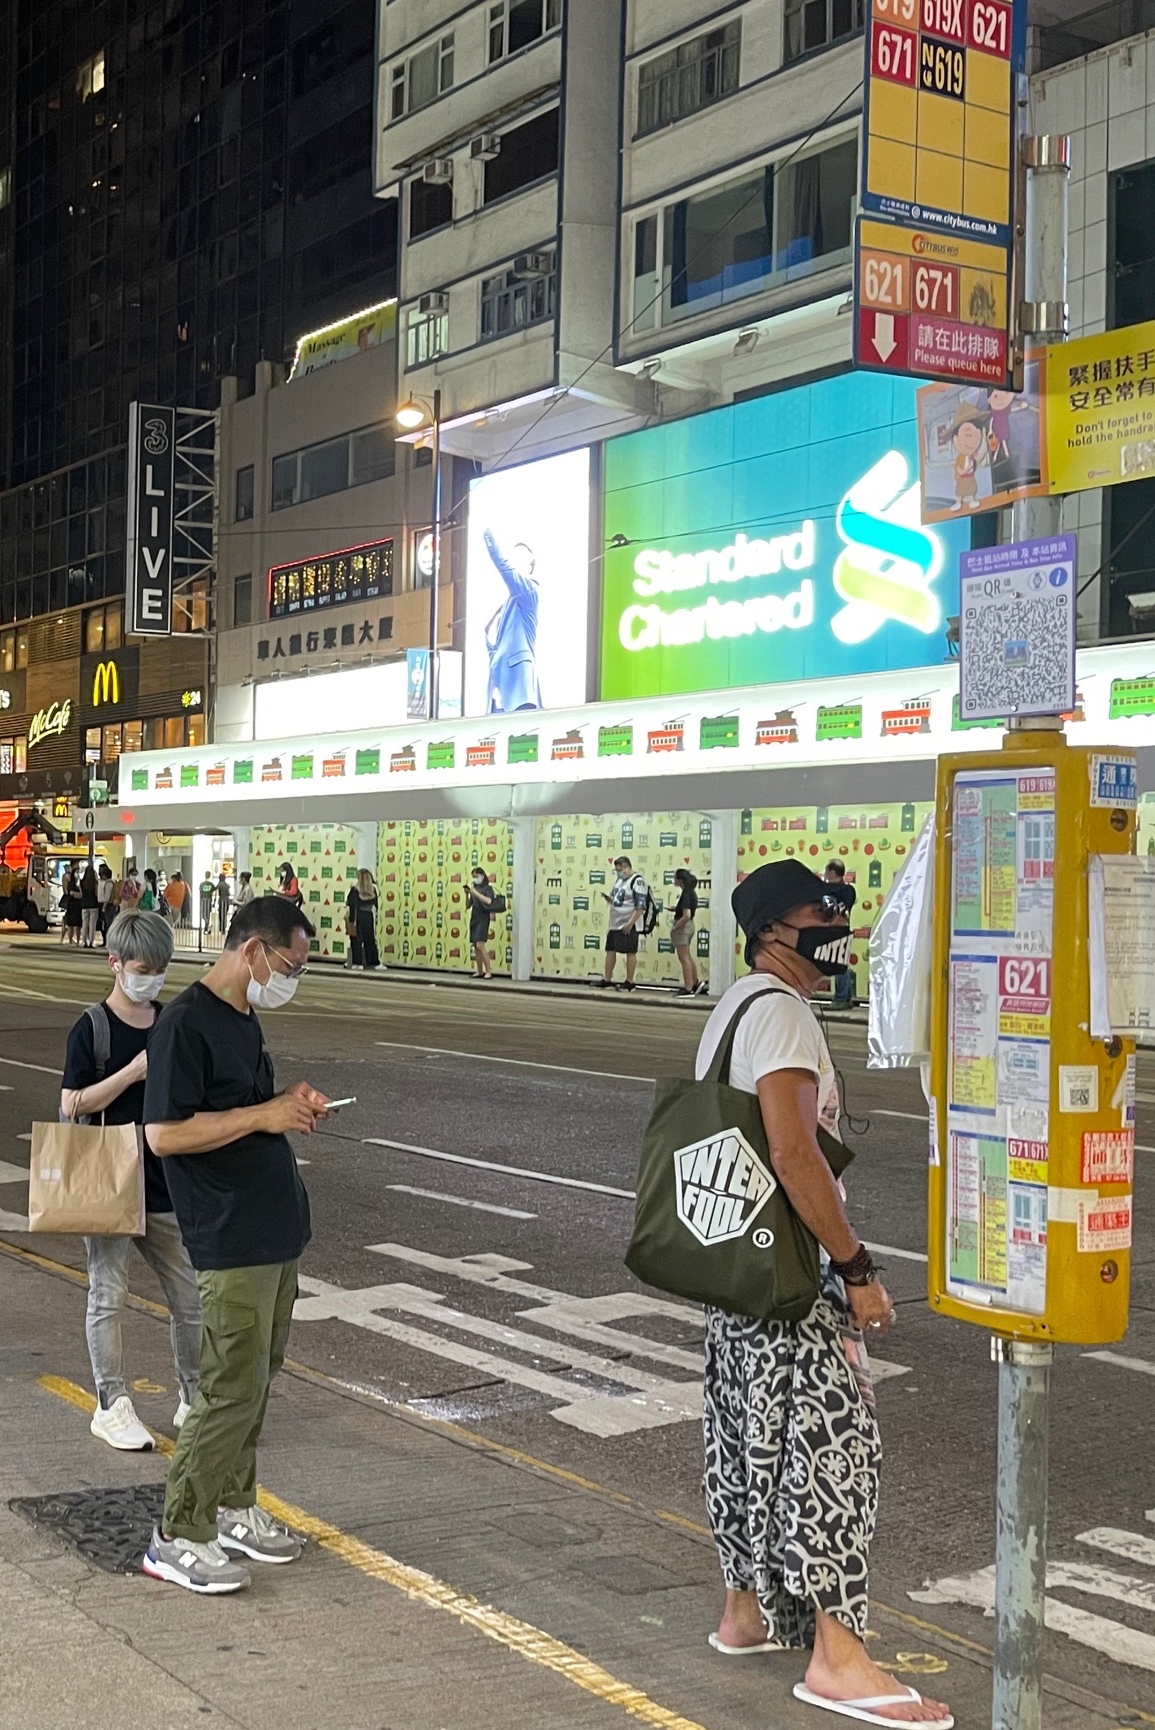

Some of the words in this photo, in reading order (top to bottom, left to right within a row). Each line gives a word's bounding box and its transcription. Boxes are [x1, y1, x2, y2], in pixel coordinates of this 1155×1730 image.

[973, 3, 1007, 52] 621
[878, 30, 912, 79] 671
[922, 209, 998, 235] www.citybus.com.hk
[865, 258, 903, 306] 621
[915, 266, 953, 314] 671
[918, 323, 999, 359] 請在此排隊
[914, 349, 946, 366] Please
[948, 357, 978, 374] queue
[980, 361, 1002, 377] here
[1068, 349, 1155, 388] 緊握扶手
[1068, 433, 1093, 449] hold
[1096, 431, 1113, 443] the
[1075, 419, 1104, 435] Don't
[1107, 413, 1139, 431] forget
[141, 464, 166, 620] LIVE
[633, 520, 815, 597] Standard
[984, 579, 1001, 598] QR
[618, 579, 815, 652] Chartered
[1019, 778, 1036, 792] 619
[1004, 959, 1048, 996] 621
[1009, 1140, 1029, 1158] 671
[679, 1135, 771, 1202] INTER
[682, 1183, 746, 1240] FOOL
